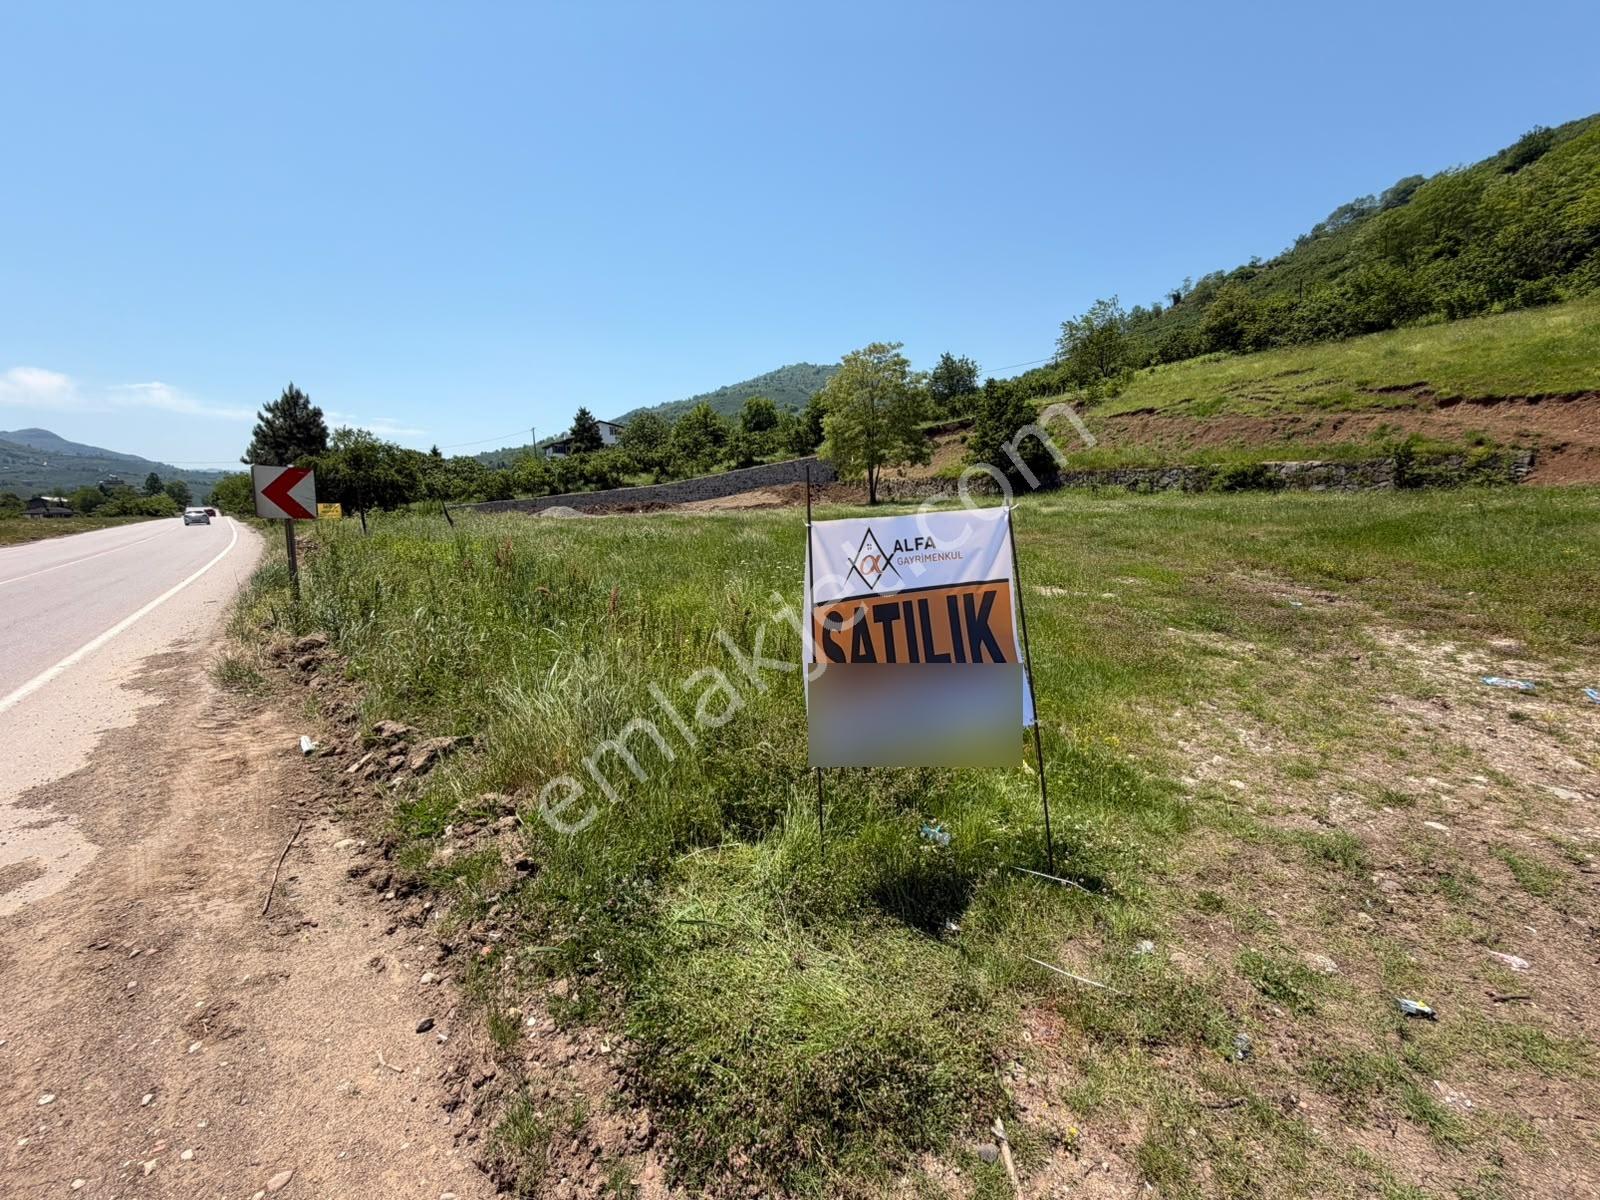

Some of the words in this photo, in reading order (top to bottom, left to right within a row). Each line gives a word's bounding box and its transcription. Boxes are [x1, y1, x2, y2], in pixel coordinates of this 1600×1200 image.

[893, 535, 937, 553] ALFA
[896, 551, 965, 567] GAYRİMENKUL
[821, 590, 1007, 664] SATILIK
